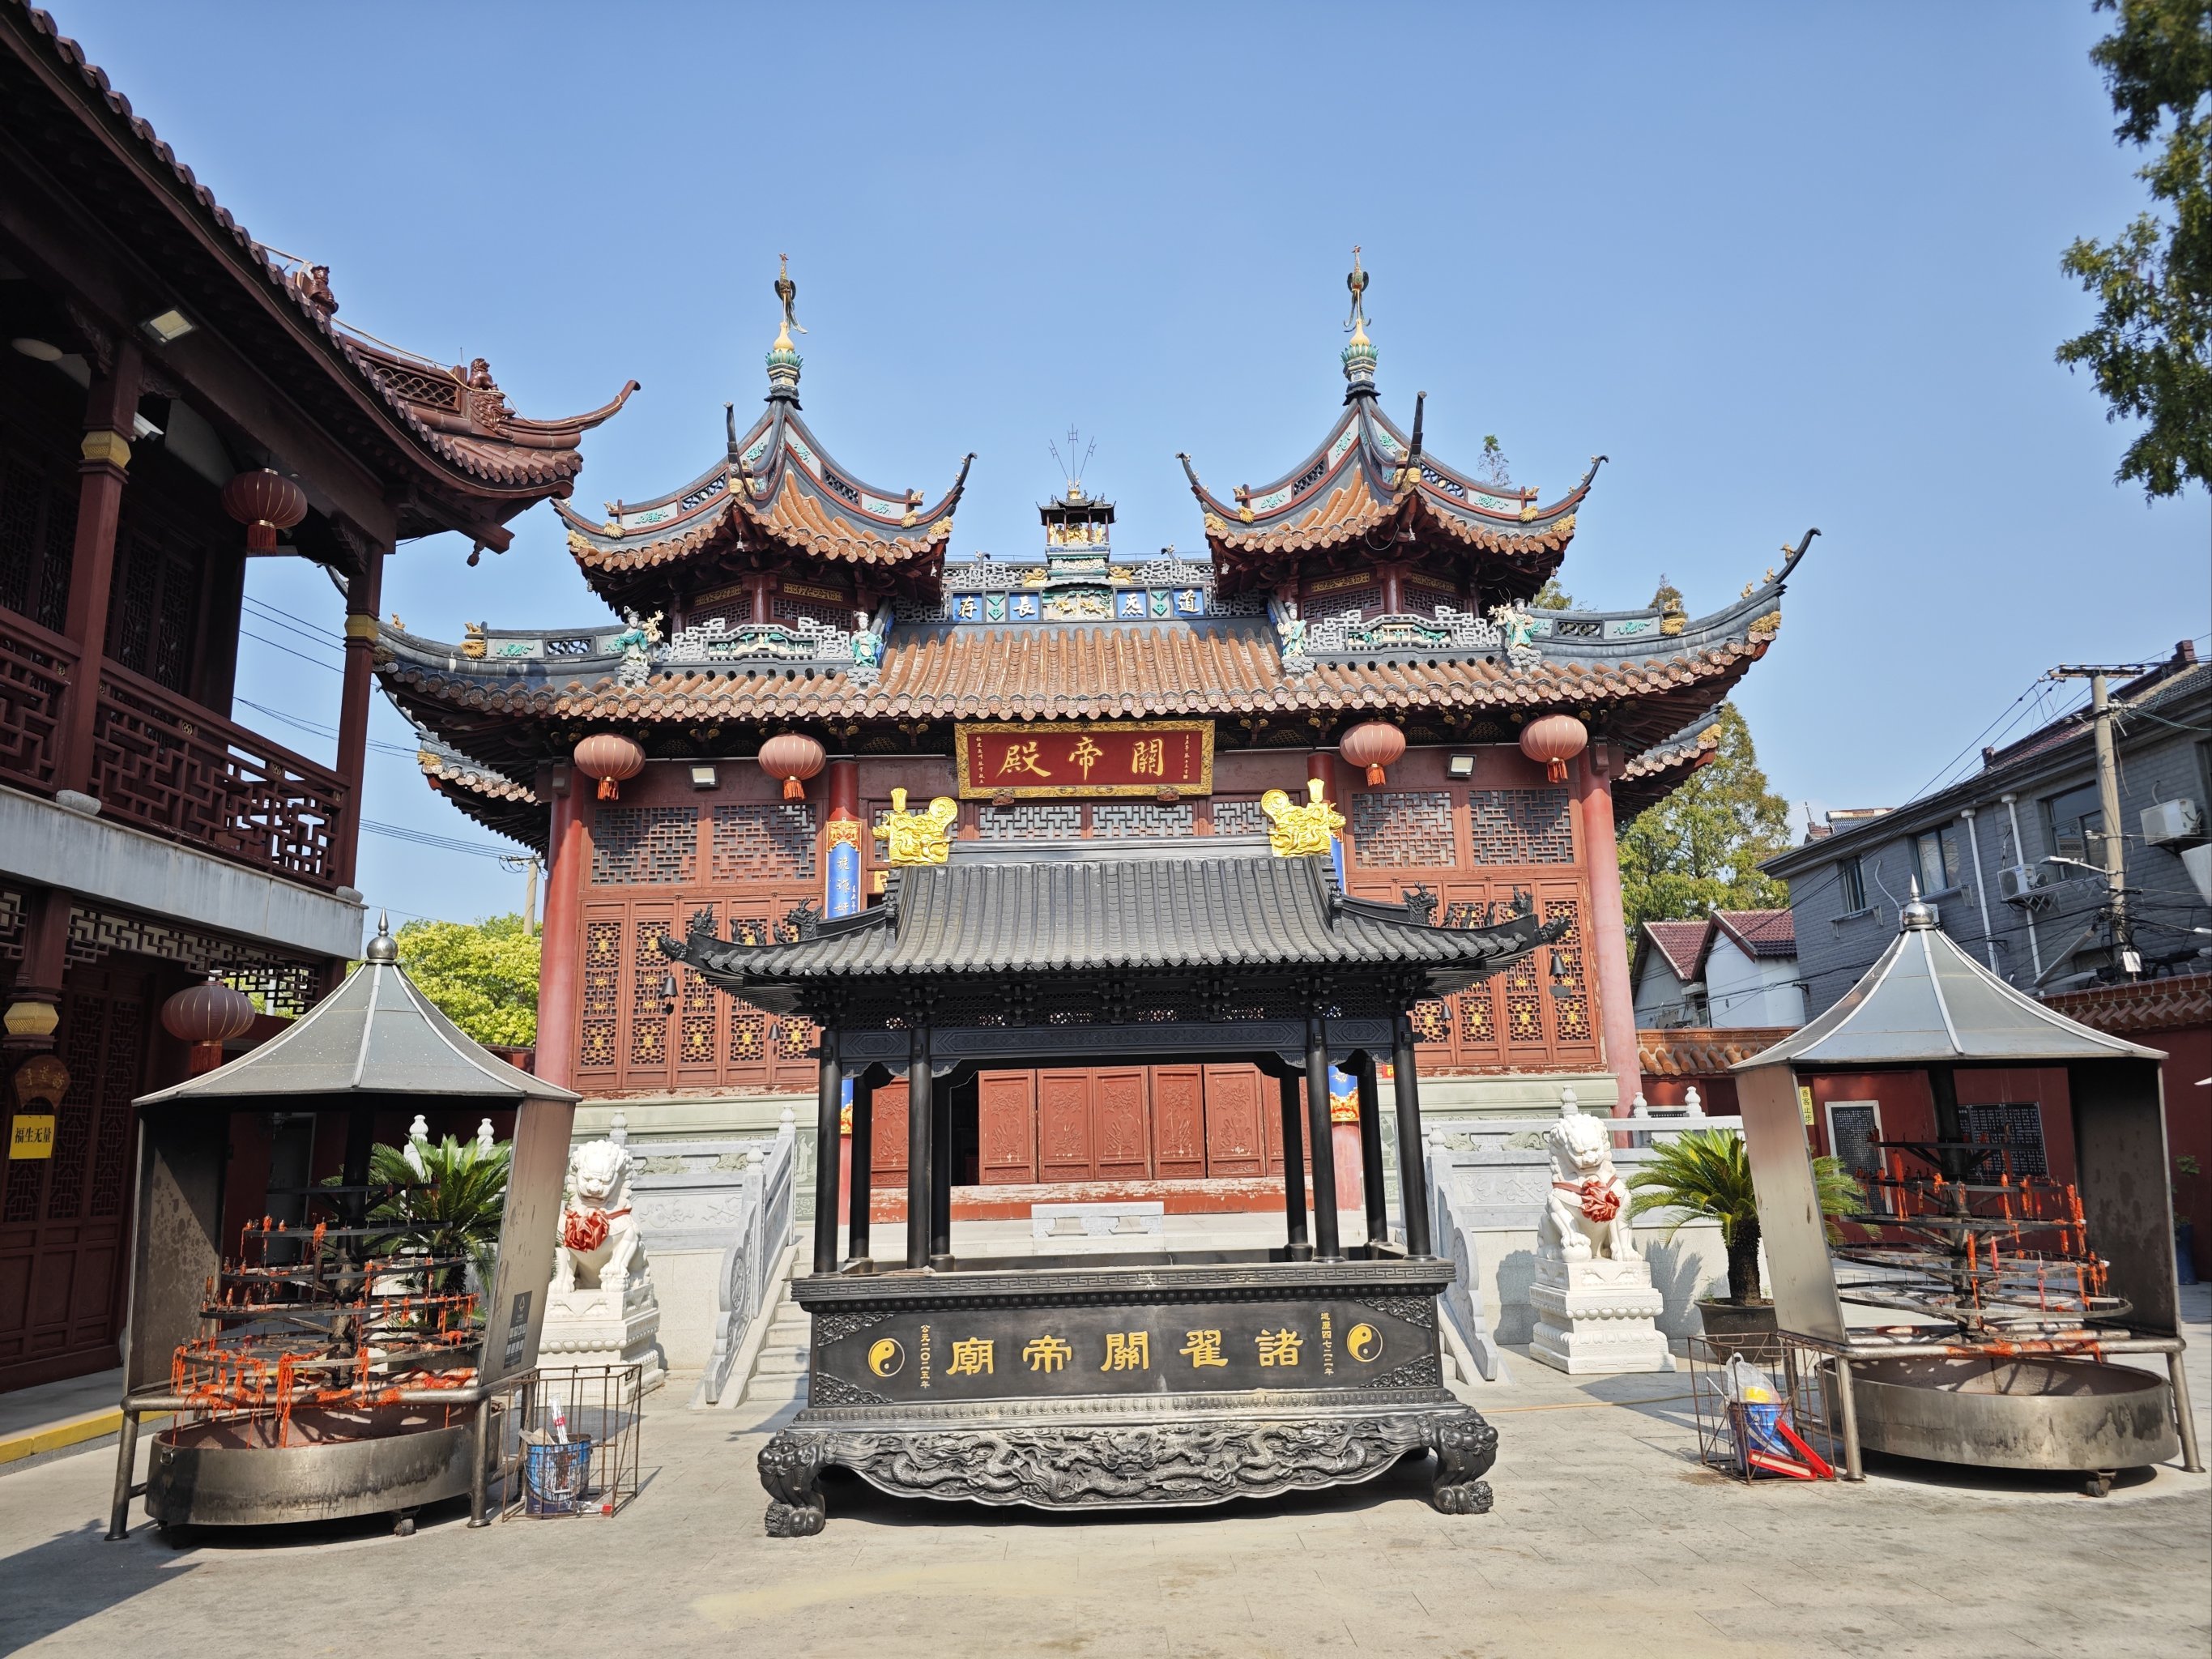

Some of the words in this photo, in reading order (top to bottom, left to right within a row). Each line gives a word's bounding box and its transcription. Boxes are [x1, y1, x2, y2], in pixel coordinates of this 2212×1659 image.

[998, 736, 1164, 781] 關帝殿
[1801, 1090, 1813, 1123] 香客止步
[15, 1127, 51, 1144] 福生无量
[946, 1329, 1304, 1375] 諸翟關帝廟
